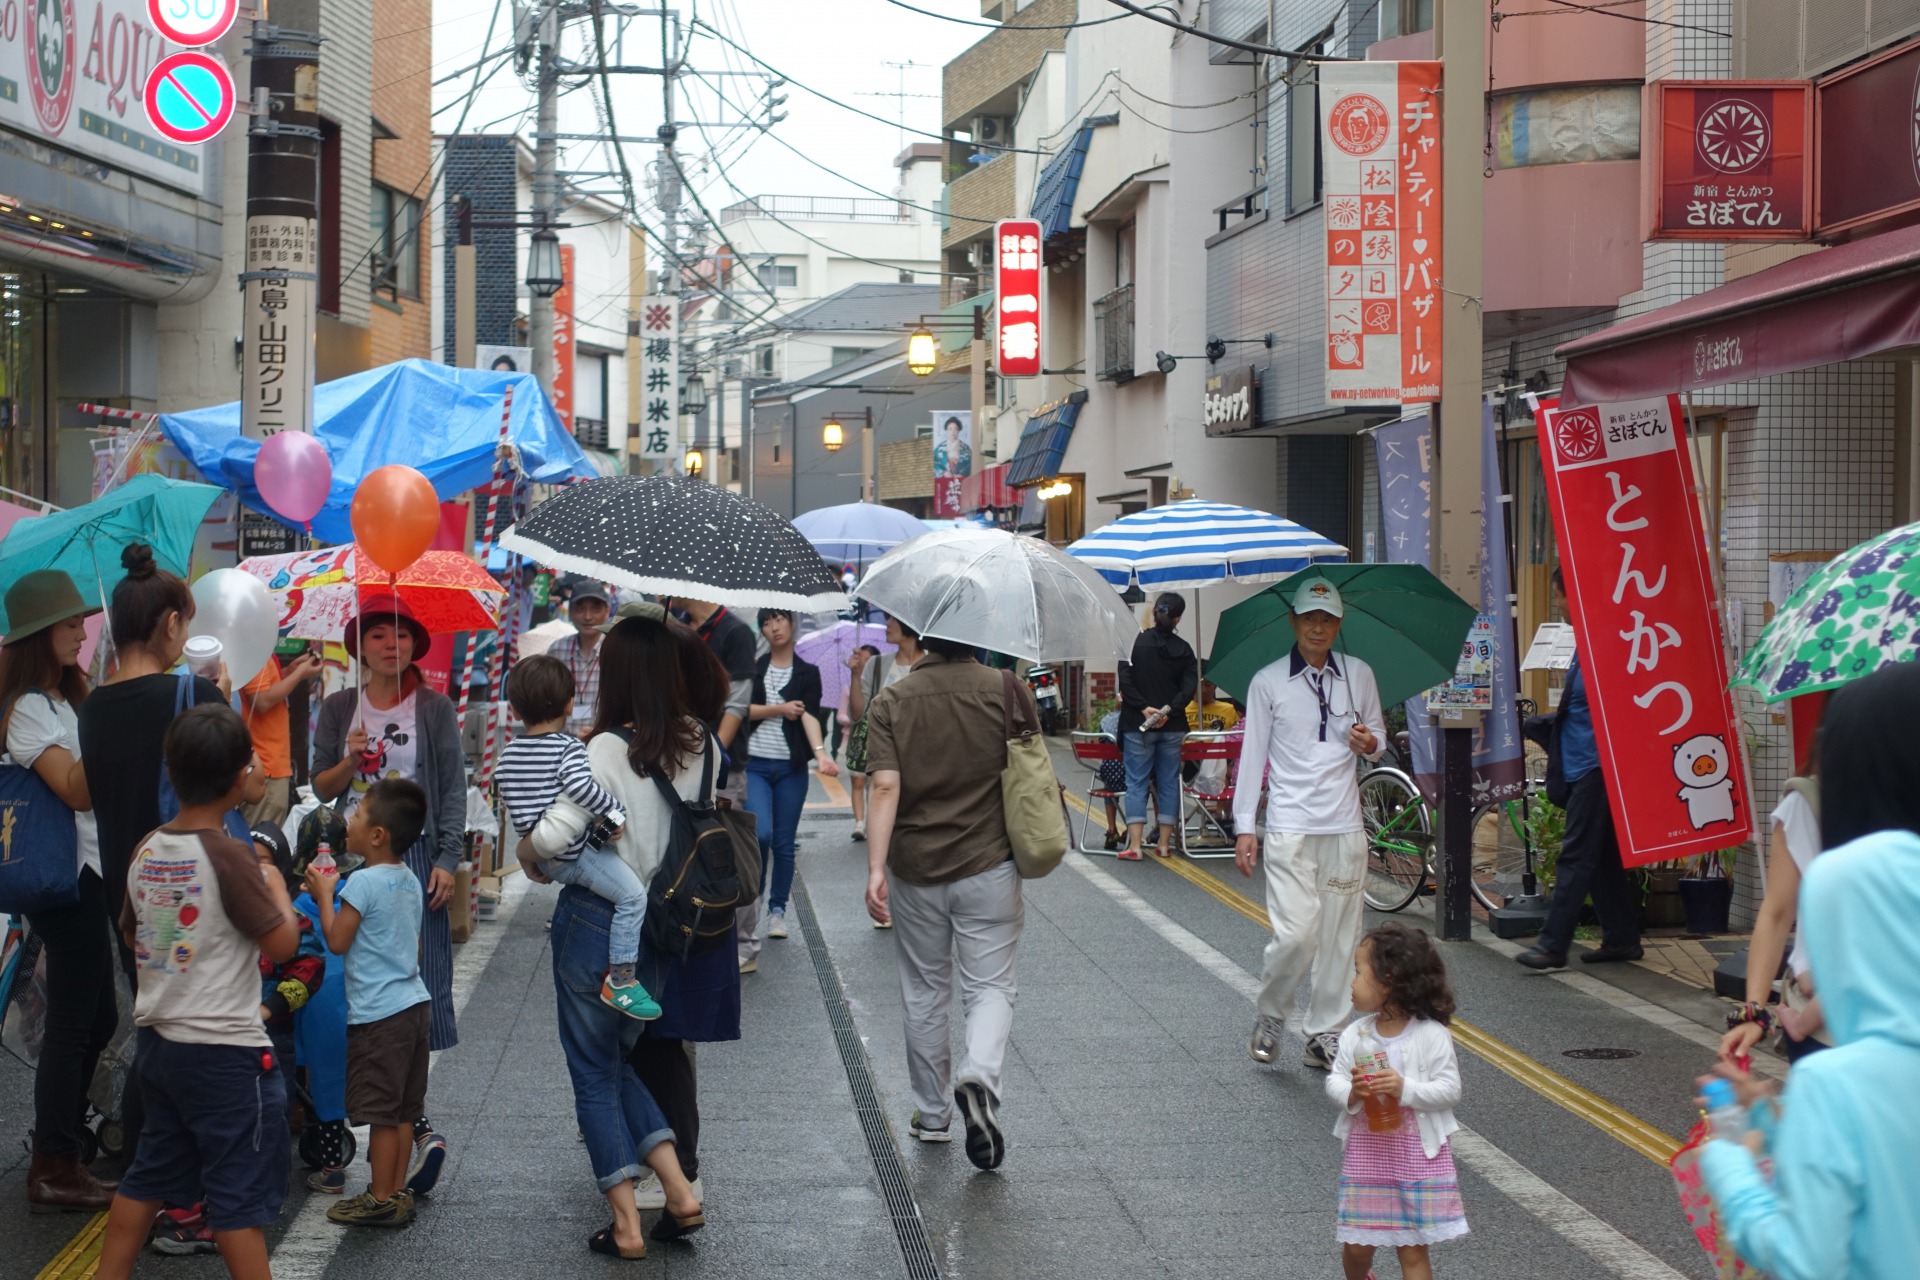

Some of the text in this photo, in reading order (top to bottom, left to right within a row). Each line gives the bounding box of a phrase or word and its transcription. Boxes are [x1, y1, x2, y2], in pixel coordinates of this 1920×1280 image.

[82, 2, 165, 119] AQU
[1693, 184, 1774, 197] 新宿 とんかつ
[1686, 200, 1782, 227] さぼてん
[1713, 336, 1743, 370] さぼてん
[1609, 408, 1659, 424] 新宿 とんかつ
[1607, 419, 1667, 443] さぼてん
[1605, 470, 1693, 737] とんかつ
[387, 877, 416, 893] Hello
